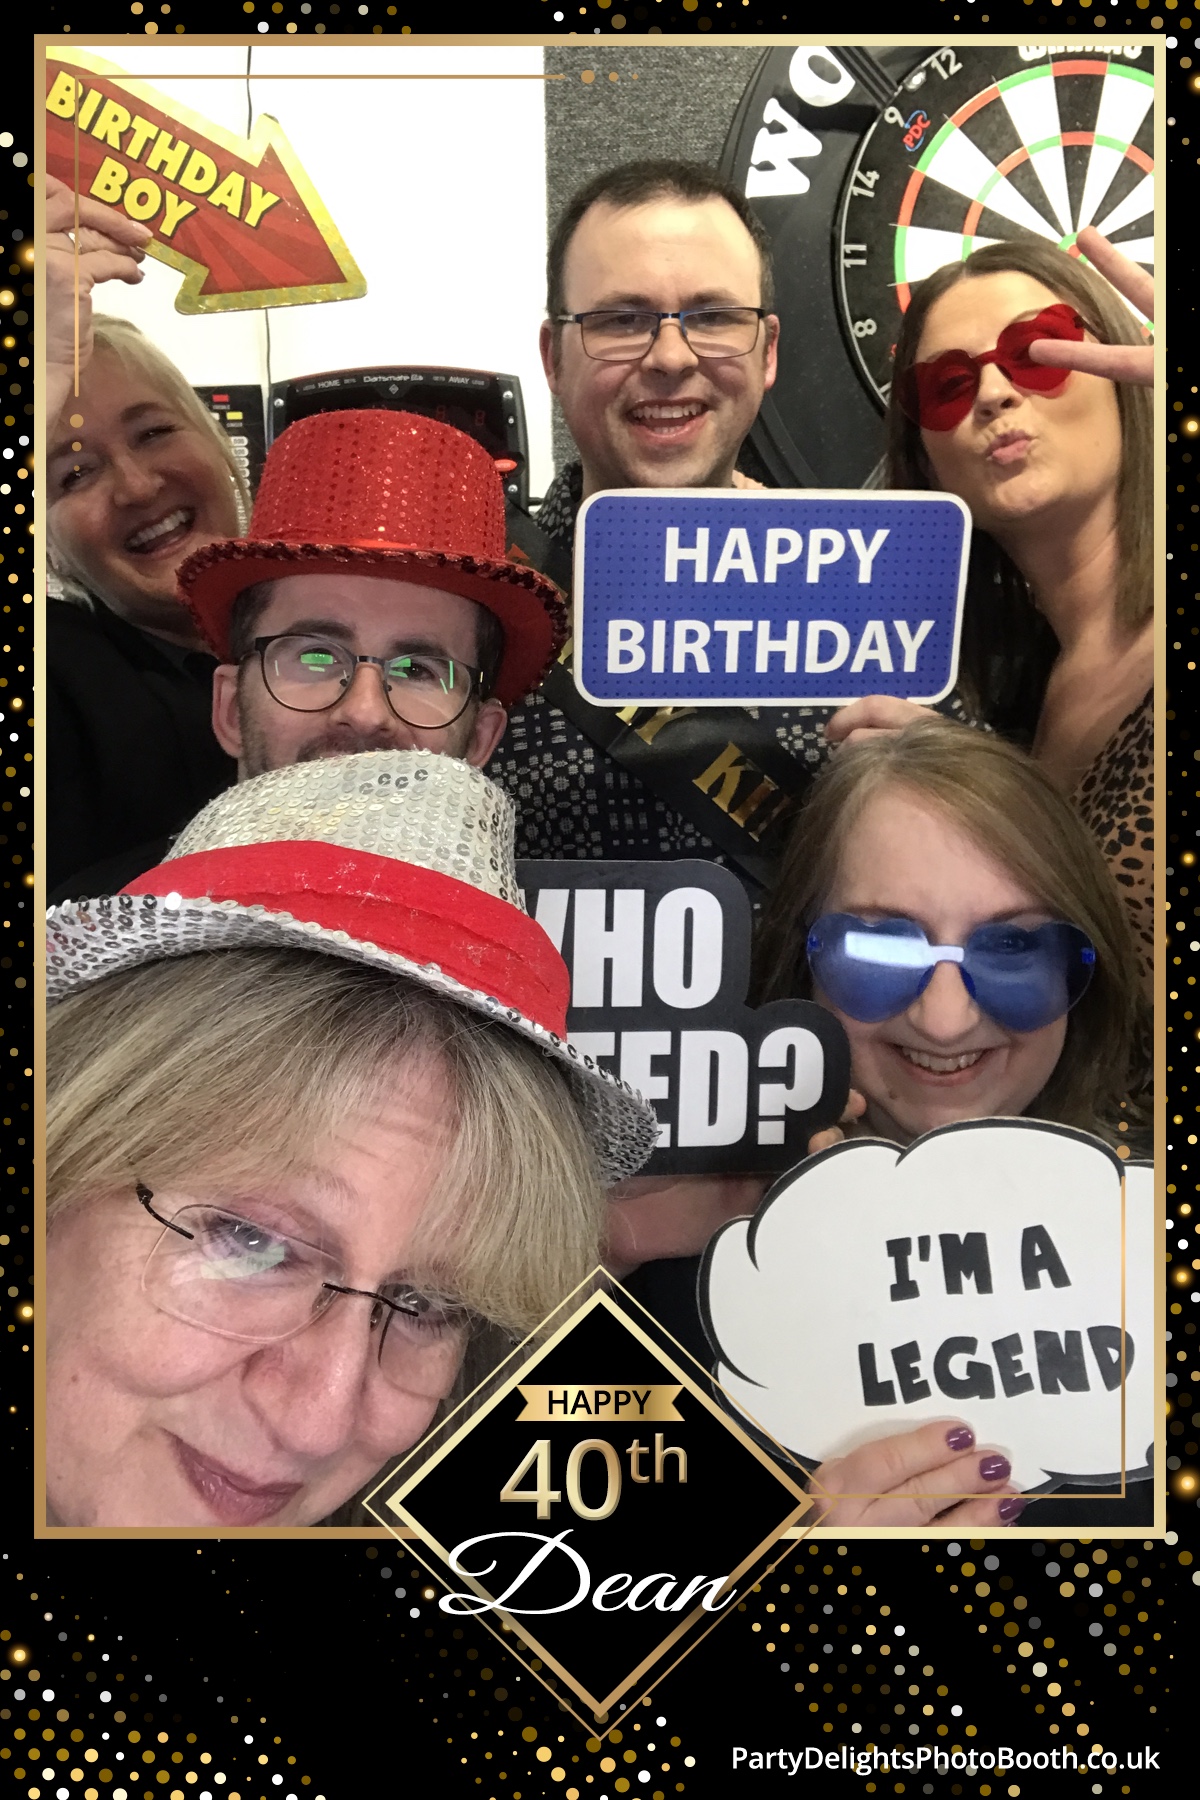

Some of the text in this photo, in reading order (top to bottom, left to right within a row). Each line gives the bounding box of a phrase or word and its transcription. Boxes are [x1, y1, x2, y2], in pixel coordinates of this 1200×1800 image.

[930, 49, 963, 80] 12
[884, 105, 905, 128] 9
[902, 113, 931, 149] PDC
[46, 70, 281, 228] BIRTHDAY
[89, 156, 198, 238] BOY
[852, 170, 880, 198] 14
[843, 243, 868, 269] 11
[853, 318, 878, 338] 8
[317, 379, 341, 389] HOME
[448, 376, 470, 385] AWAY
[664, 526, 891, 584] HAPPY
[606, 619, 935, 674] BIRTHDAY
[885, 1224, 1072, 1302] I'M A
[857, 1324, 1135, 1407] LEGEND
